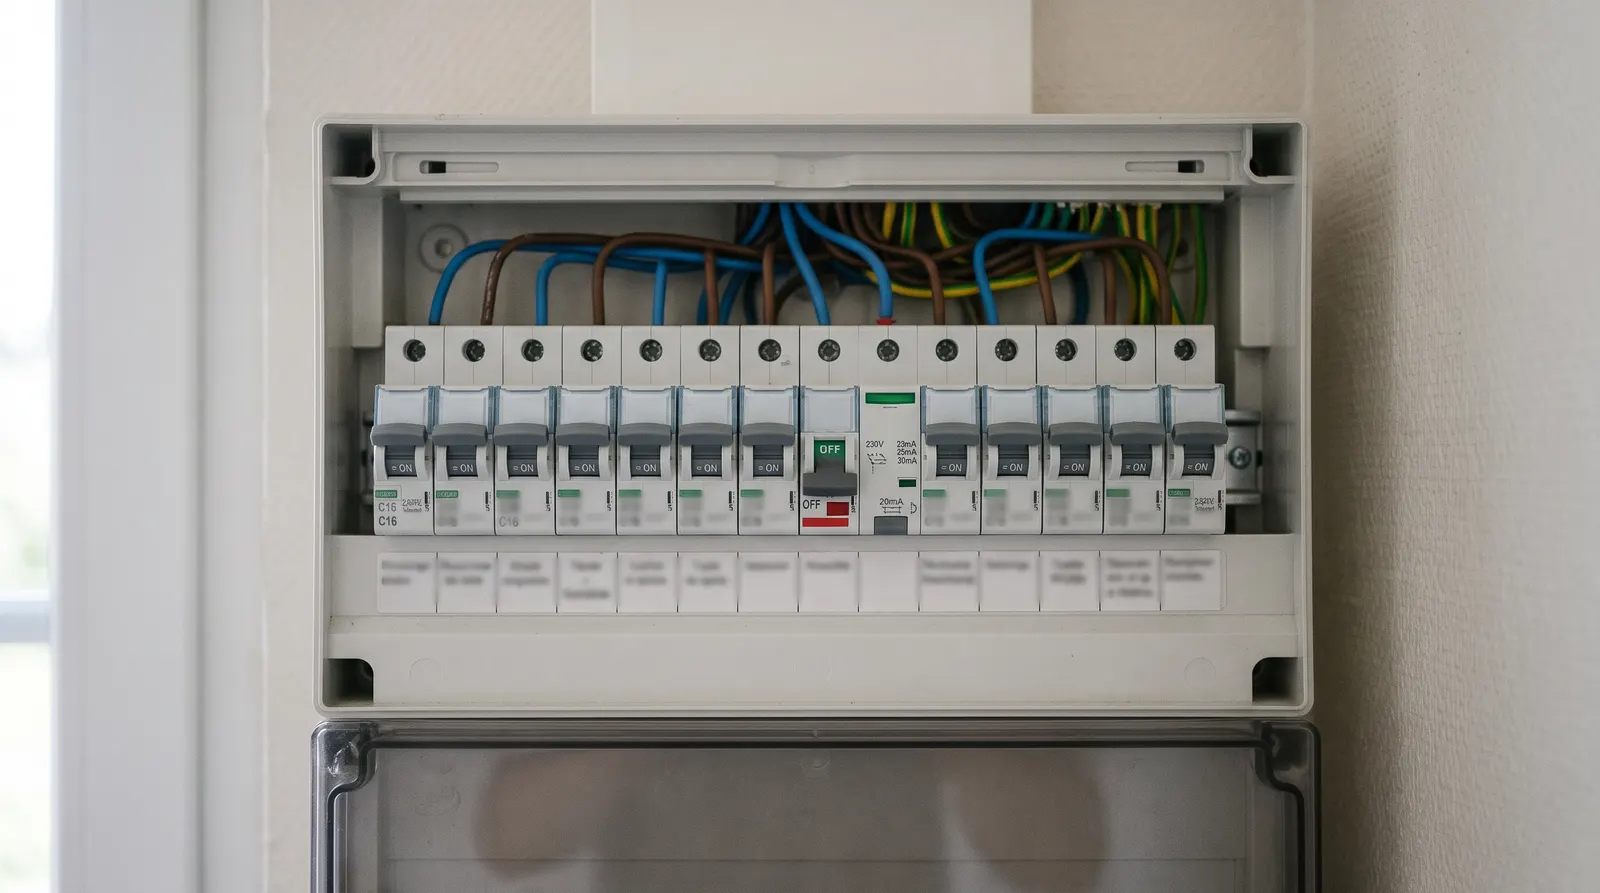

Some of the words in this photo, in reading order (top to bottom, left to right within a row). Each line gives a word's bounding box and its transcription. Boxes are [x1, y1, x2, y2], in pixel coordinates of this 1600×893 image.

[896, 440, 917, 448] 23mA
[819, 445, 841, 454] OFF
[896, 448, 917, 456] 25mA
[897, 457, 918, 465] 30mA
[398, 463, 413, 472] ON
[460, 463, 474, 472] ON
[520, 463, 534, 472] ON
[581, 463, 595, 472] ON
[643, 463, 657, 472] ON
[704, 463, 718, 472] ON
[765, 463, 779, 472] ON
[948, 463, 962, 472] ON
[1009, 463, 1023, 472] ON
[1071, 463, 1085, 472] ON
[1132, 463, 1147, 472] ON
[1194, 463, 1209, 472] ON
[378, 502, 397, 512] C16
[802, 499, 821, 510] OFF
[378, 516, 397, 526] C16
